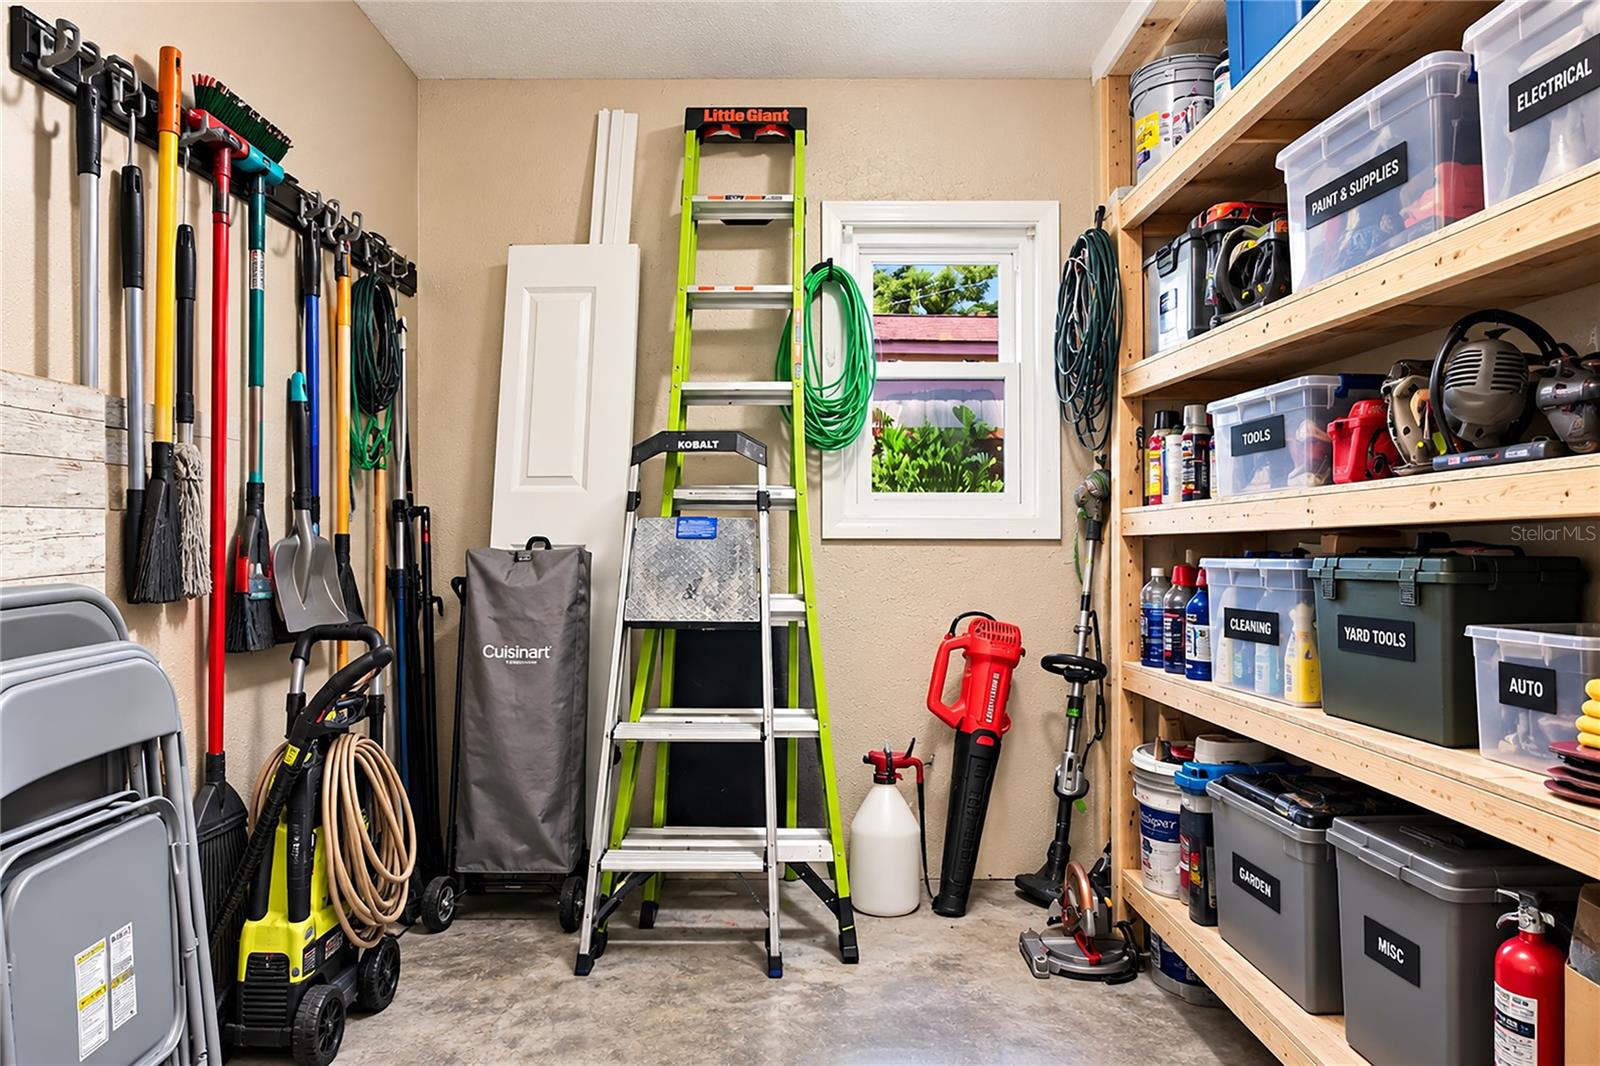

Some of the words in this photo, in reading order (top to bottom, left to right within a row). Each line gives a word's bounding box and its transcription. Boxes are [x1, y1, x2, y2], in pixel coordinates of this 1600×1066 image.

[1517, 58, 1593, 113] ELECTRICAL
[703, 109, 744, 122] Little
[746, 109, 790, 122] Giant
[1311, 191, 1339, 217] PAINT
[1340, 187, 1347, 201] &
[1349, 159, 1399, 197] SUPPLIES
[677, 440, 720, 449] KOBALT
[1242, 428, 1271, 446] TOOLS
[1230, 618, 1272, 635] CLEANING
[1344, 626, 1370, 643] YARD
[1372, 629, 1407, 648] TOOLS
[482, 644, 552, 659] Cuisinart
[1509, 677, 1543, 698] AUTO
[1239, 866, 1272, 898] GARDEN
[1378, 936, 1404, 964] MISC
